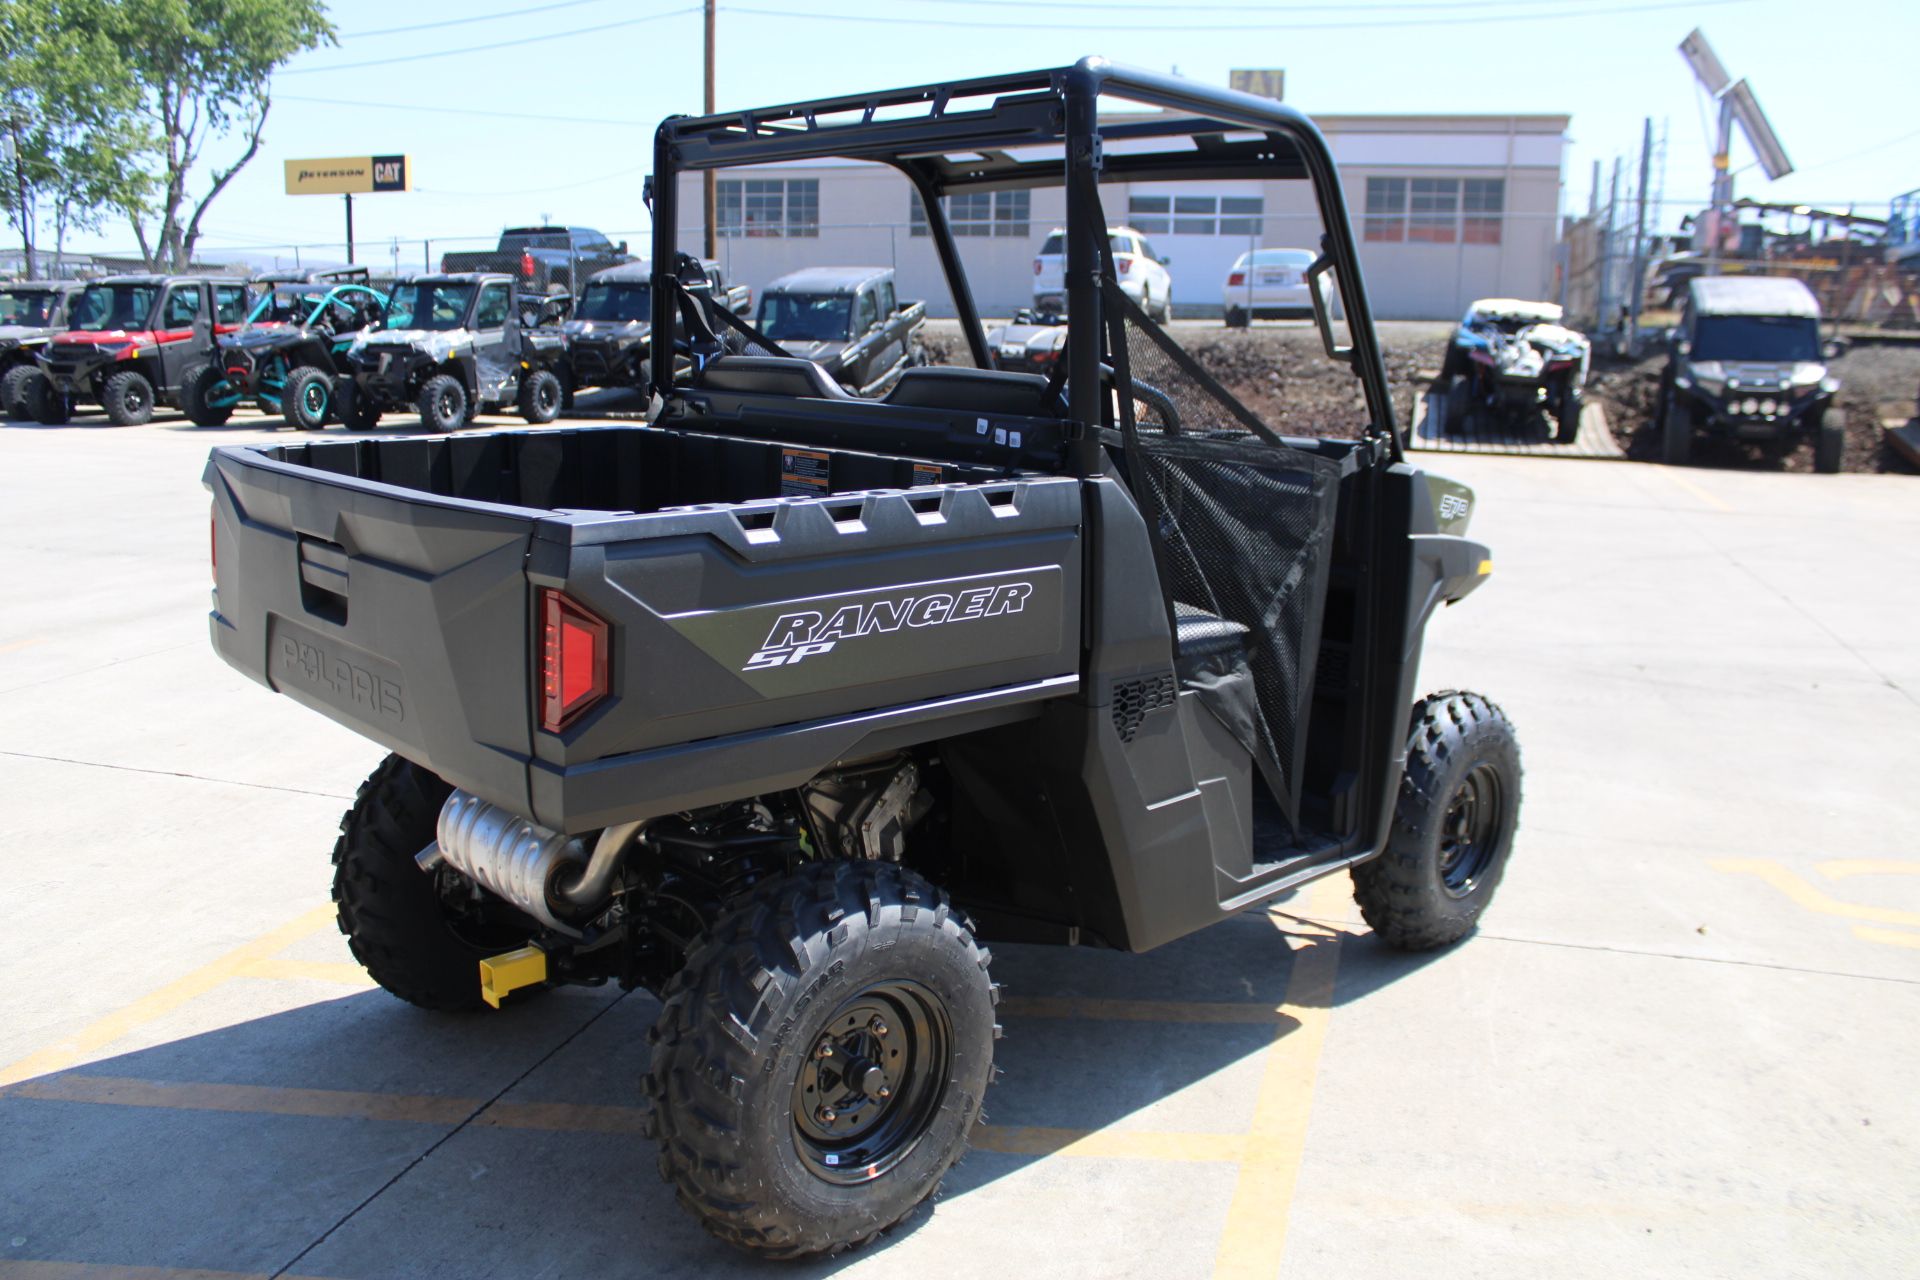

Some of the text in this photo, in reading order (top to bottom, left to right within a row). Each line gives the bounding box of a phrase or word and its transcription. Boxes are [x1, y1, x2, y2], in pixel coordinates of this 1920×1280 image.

[375, 162, 401, 183] CAT
[761, 582, 1033, 649] RANGER
[280, 635, 404, 723] POLARIS
[741, 641, 836, 671] SP
